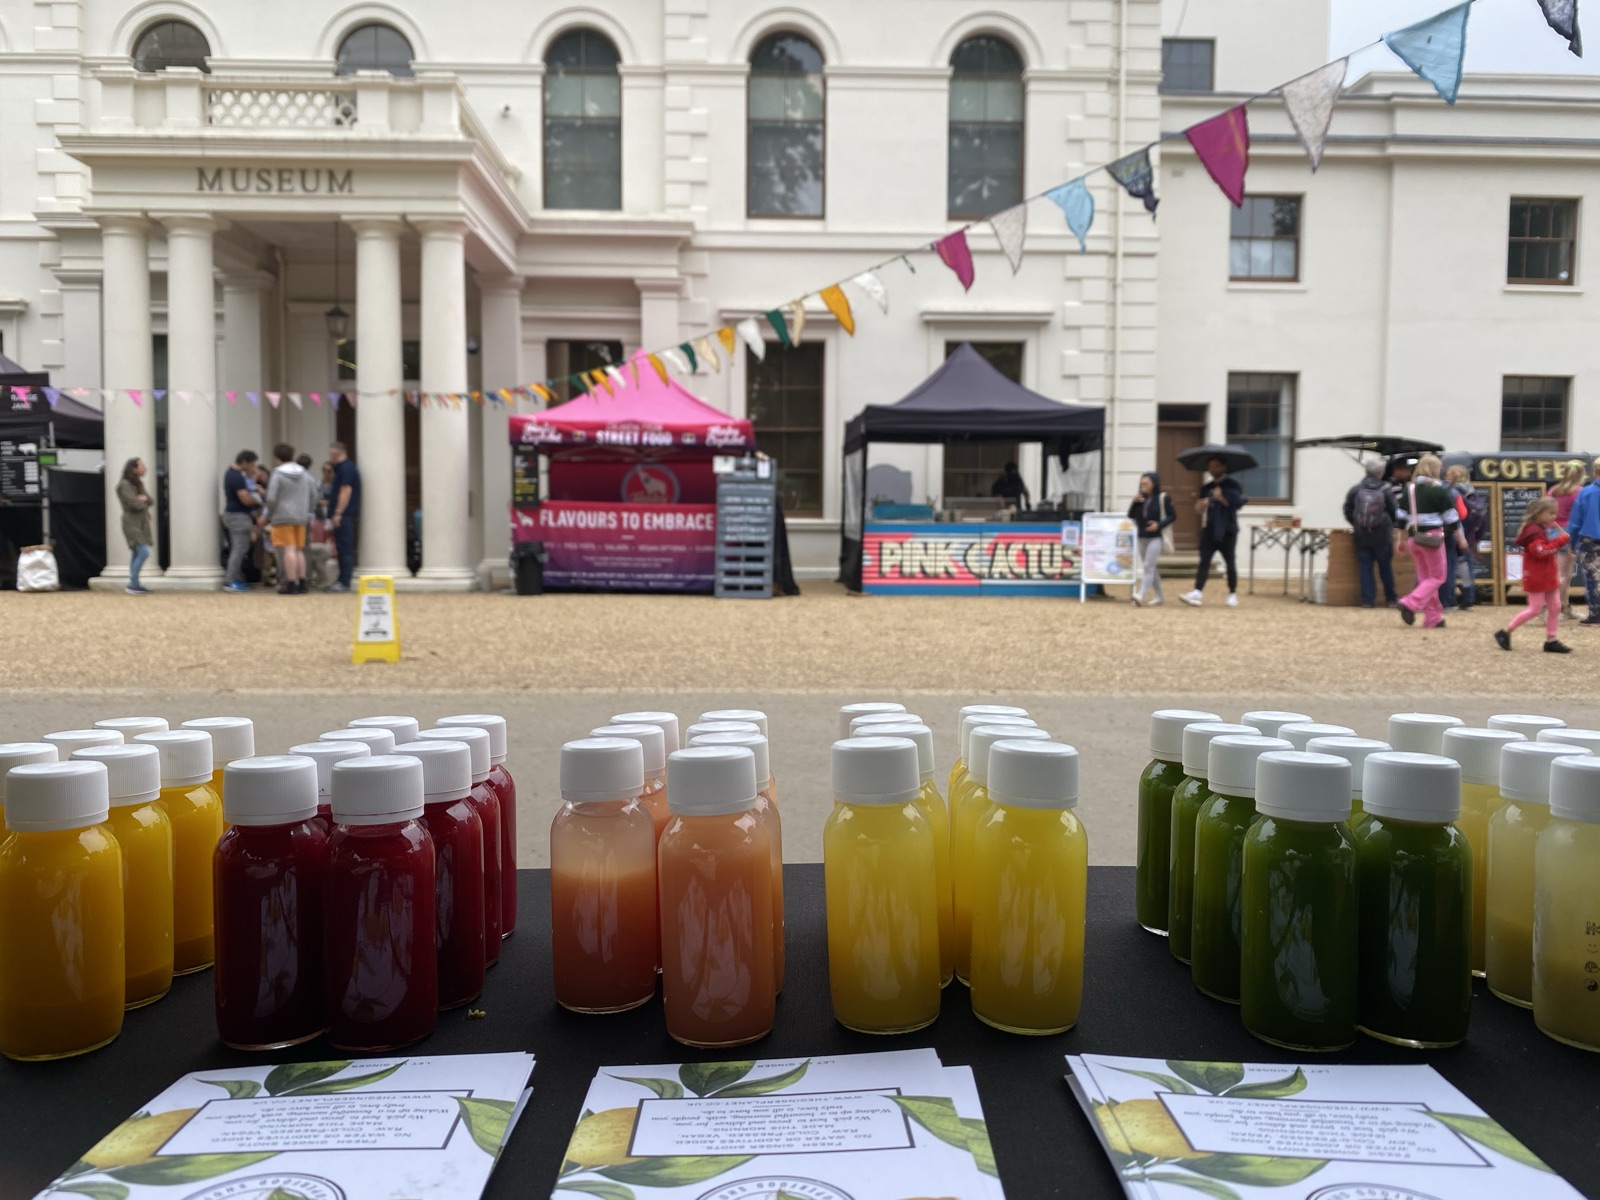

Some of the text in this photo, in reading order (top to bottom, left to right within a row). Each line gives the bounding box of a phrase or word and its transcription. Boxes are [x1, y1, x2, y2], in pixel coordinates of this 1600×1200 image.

[196, 166, 354, 193] MUSEUM
[595, 430, 673, 447] STREET FOOD
[1479, 458, 1590, 480] COFFE
[1503, 490, 1515, 500] WE
[540, 510, 617, 529] FLAVOURS
[621, 512, 640, 529] TO
[643, 512, 714, 531] EMBRACE
[879, 541, 960, 578] PINK
[964, 541, 1082, 579] CACTUS
